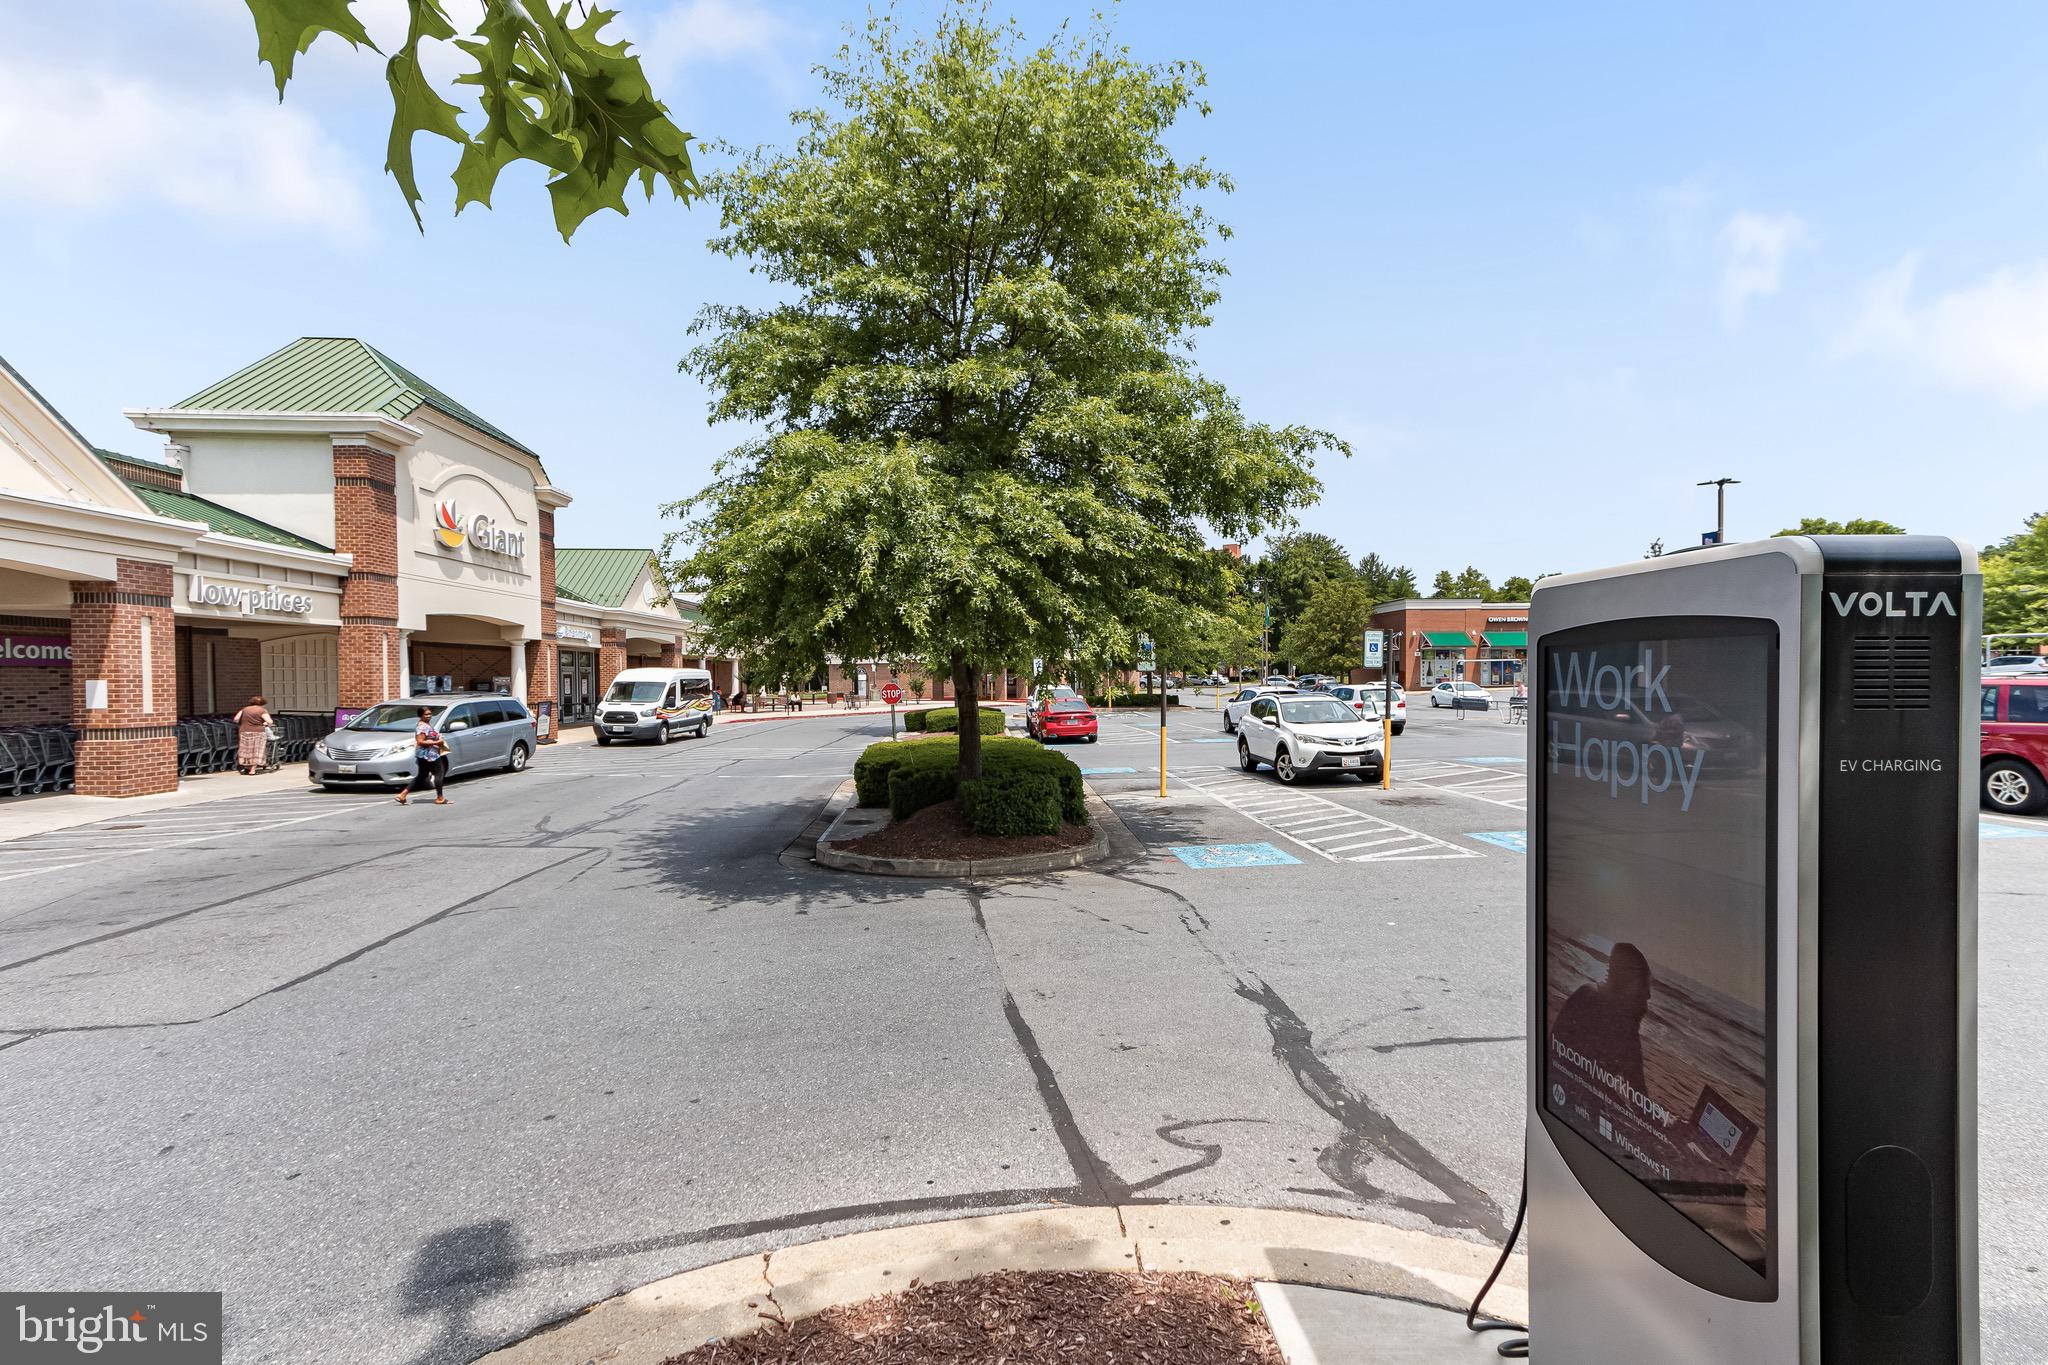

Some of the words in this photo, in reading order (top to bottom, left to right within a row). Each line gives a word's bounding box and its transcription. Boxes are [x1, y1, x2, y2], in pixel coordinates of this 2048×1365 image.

[470, 514, 525, 558] Giant
[192, 575, 240, 606] low
[242, 584, 313, 615] prices
[1829, 591, 1957, 617] VOLTA
[882, 689, 901, 699] STOP
[1553, 649, 1673, 713] Work
[1552, 720, 1705, 812] Happy
[1840, 760, 1858, 772] EV
[1862, 760, 1942, 772] CHARGING
[1552, 1033, 1671, 1127] hp.com/workhappy
[1614, 1130, 1661, 1173] Windows
[1660, 1164, 1670, 1181] 11
